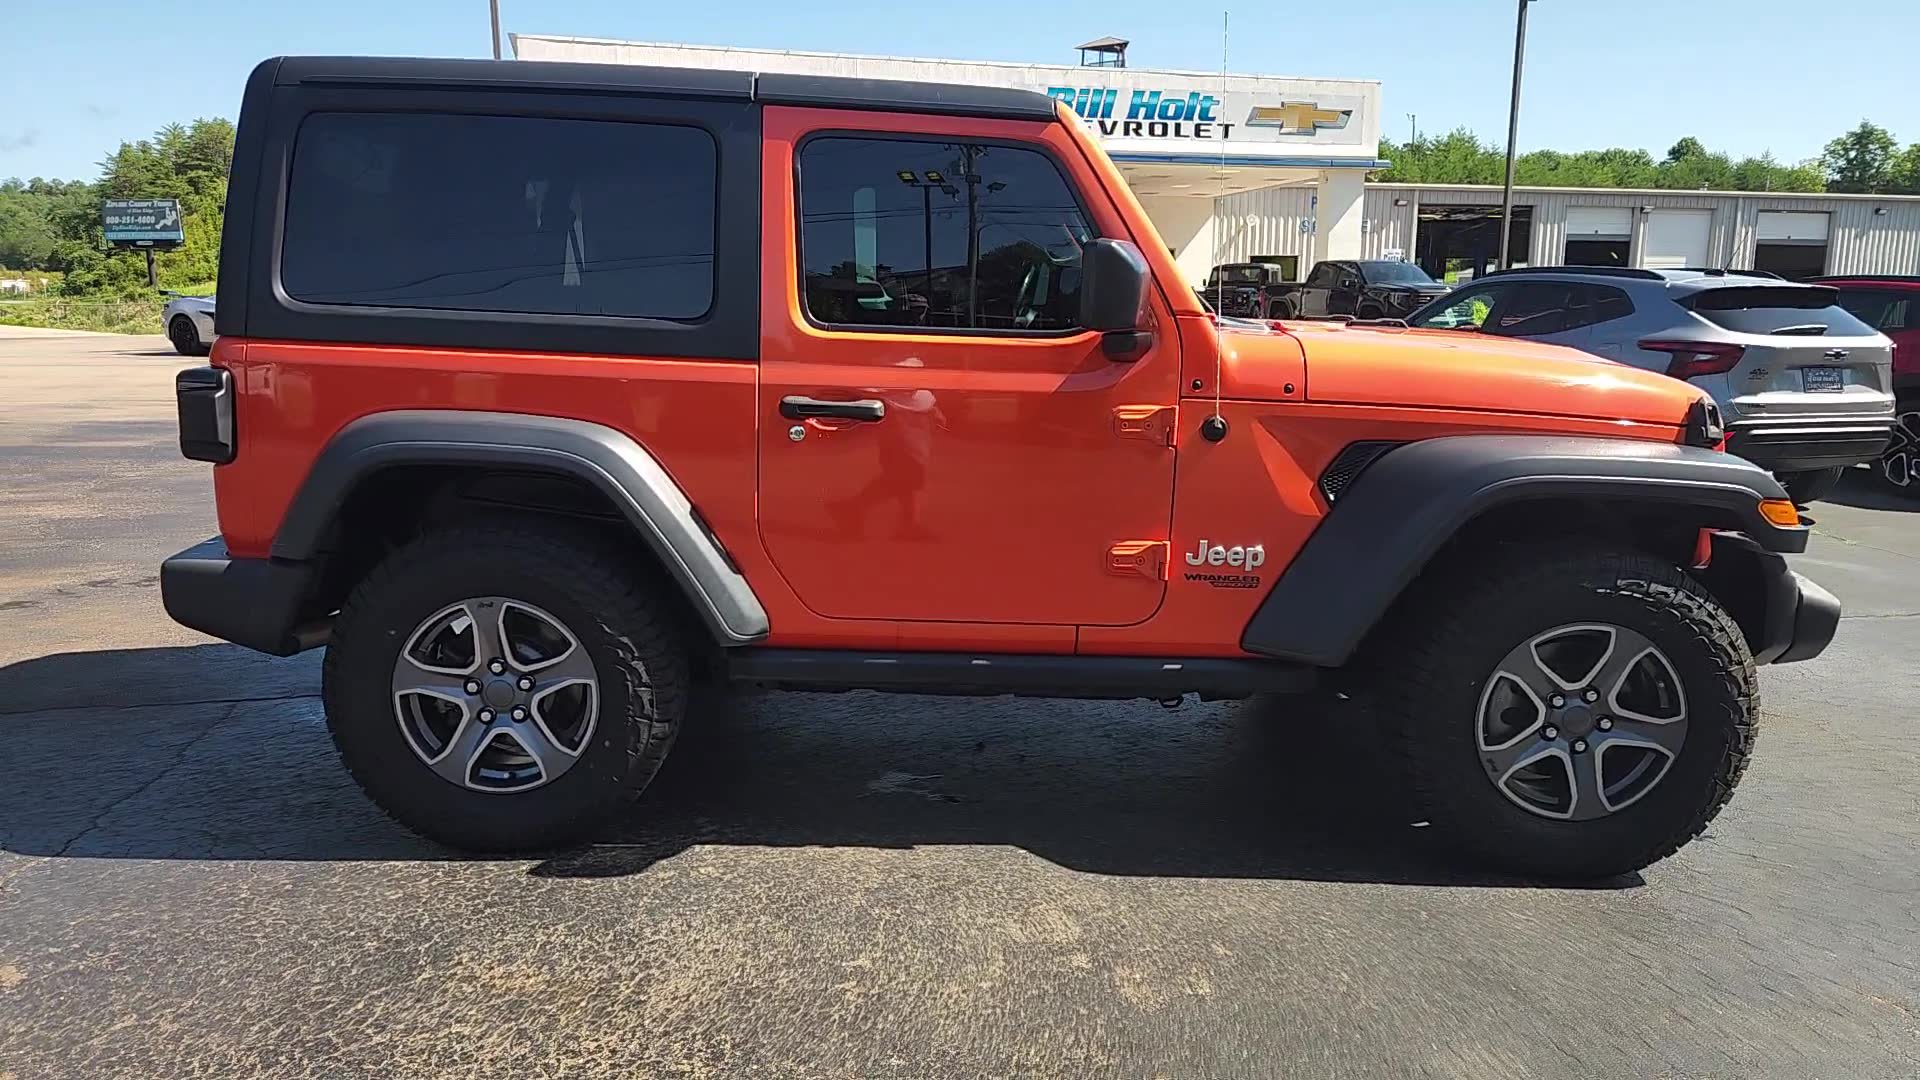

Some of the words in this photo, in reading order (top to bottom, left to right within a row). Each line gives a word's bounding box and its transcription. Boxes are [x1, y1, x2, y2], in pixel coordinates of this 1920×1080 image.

[1047, 87, 1118, 119] Bill
[1126, 90, 1220, 122] Holt
[1087, 119, 1235, 139] VROLET
[1185, 540, 1265, 571] Jeep
[1184, 573, 1260, 582] WRANGLER
